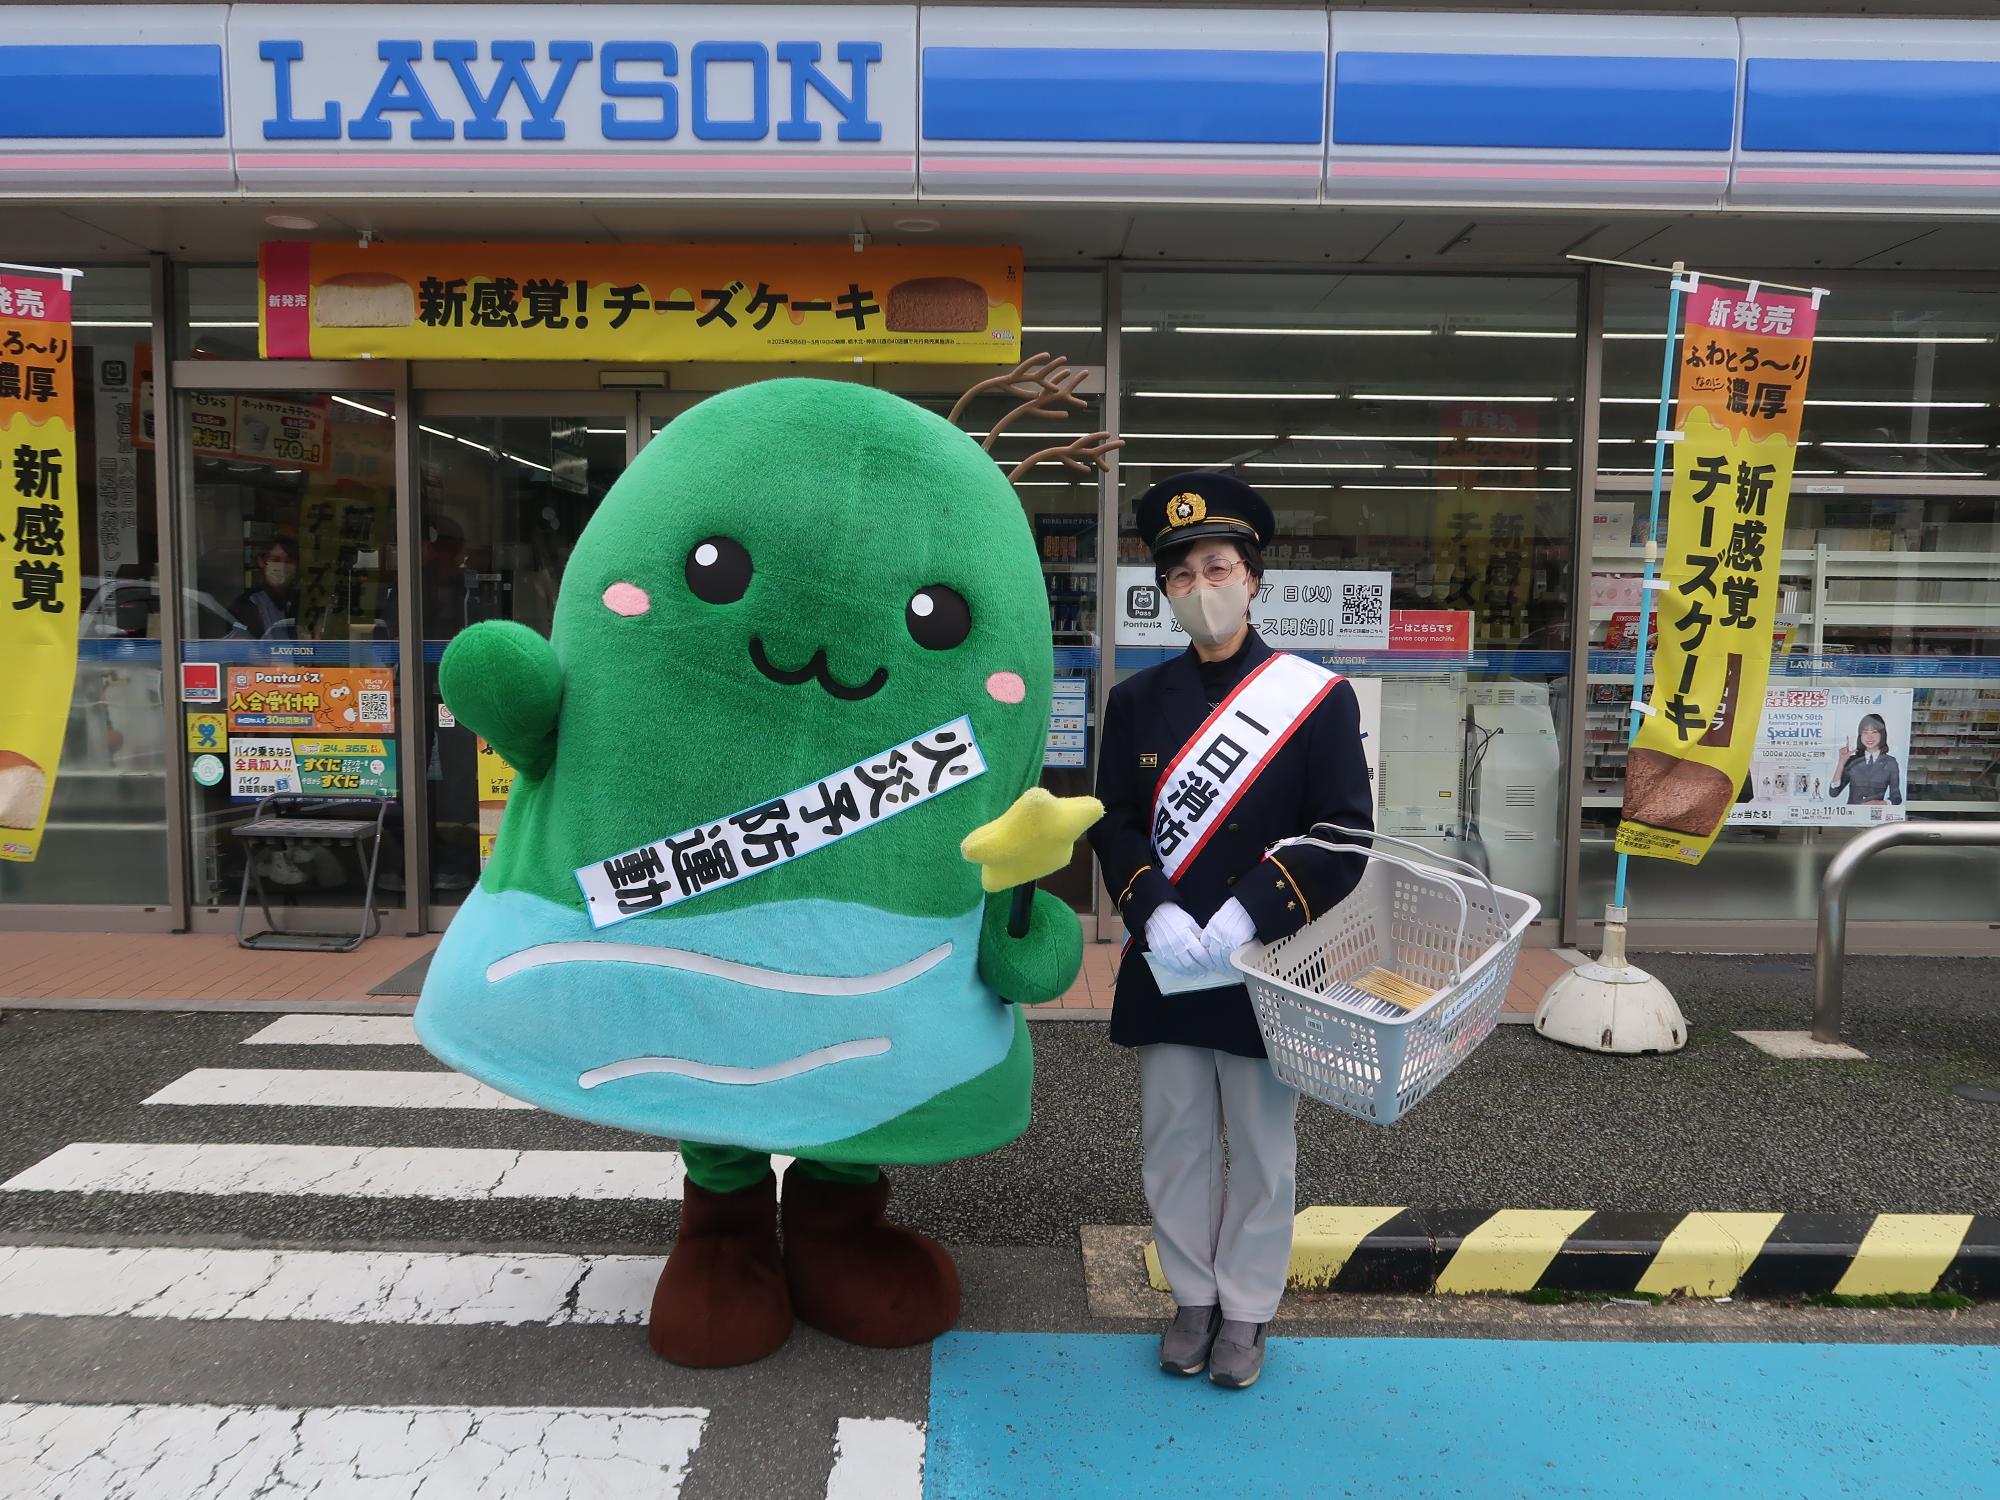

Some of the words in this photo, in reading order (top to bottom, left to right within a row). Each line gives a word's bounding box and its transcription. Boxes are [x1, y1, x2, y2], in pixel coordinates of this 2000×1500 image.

[258, 40, 882, 142] LAWSON
[268, 294, 308, 308] 新発売
[419, 276, 881, 331] 新感覚!チーズケーキ
[1707, 298, 1796, 335] 新発売
[1694, 377, 1721, 387] なのに
[1726, 377, 1792, 420] 濃厚
[12, 444, 65, 614] 新感覚
[1719, 460, 1777, 630] 新感覚
[1283, 584, 1332, 603] 日(火)
[1663, 455, 1732, 742] チーズケーキ
[1414, 636, 1429, 644] copy
[270, 647, 314, 655] LAWSON
[1321, 656, 1367, 664] LAWSON
[255, 672, 320, 684] Pontaパス
[185, 688, 216, 697] SECOM
[230, 691, 321, 712] 入会受付中
[1831, 695, 1871, 705] 日向坂46
[1767, 727, 1799, 740] Special
[1801, 728, 1823, 738] LIVE
[234, 746, 292, 757] バイク乗るなら
[235, 759, 292, 771] 全員加入!!
[304, 758, 342, 772] すぐに
[238, 777, 260, 785] バイク
[321, 775, 360, 789] すぐに
